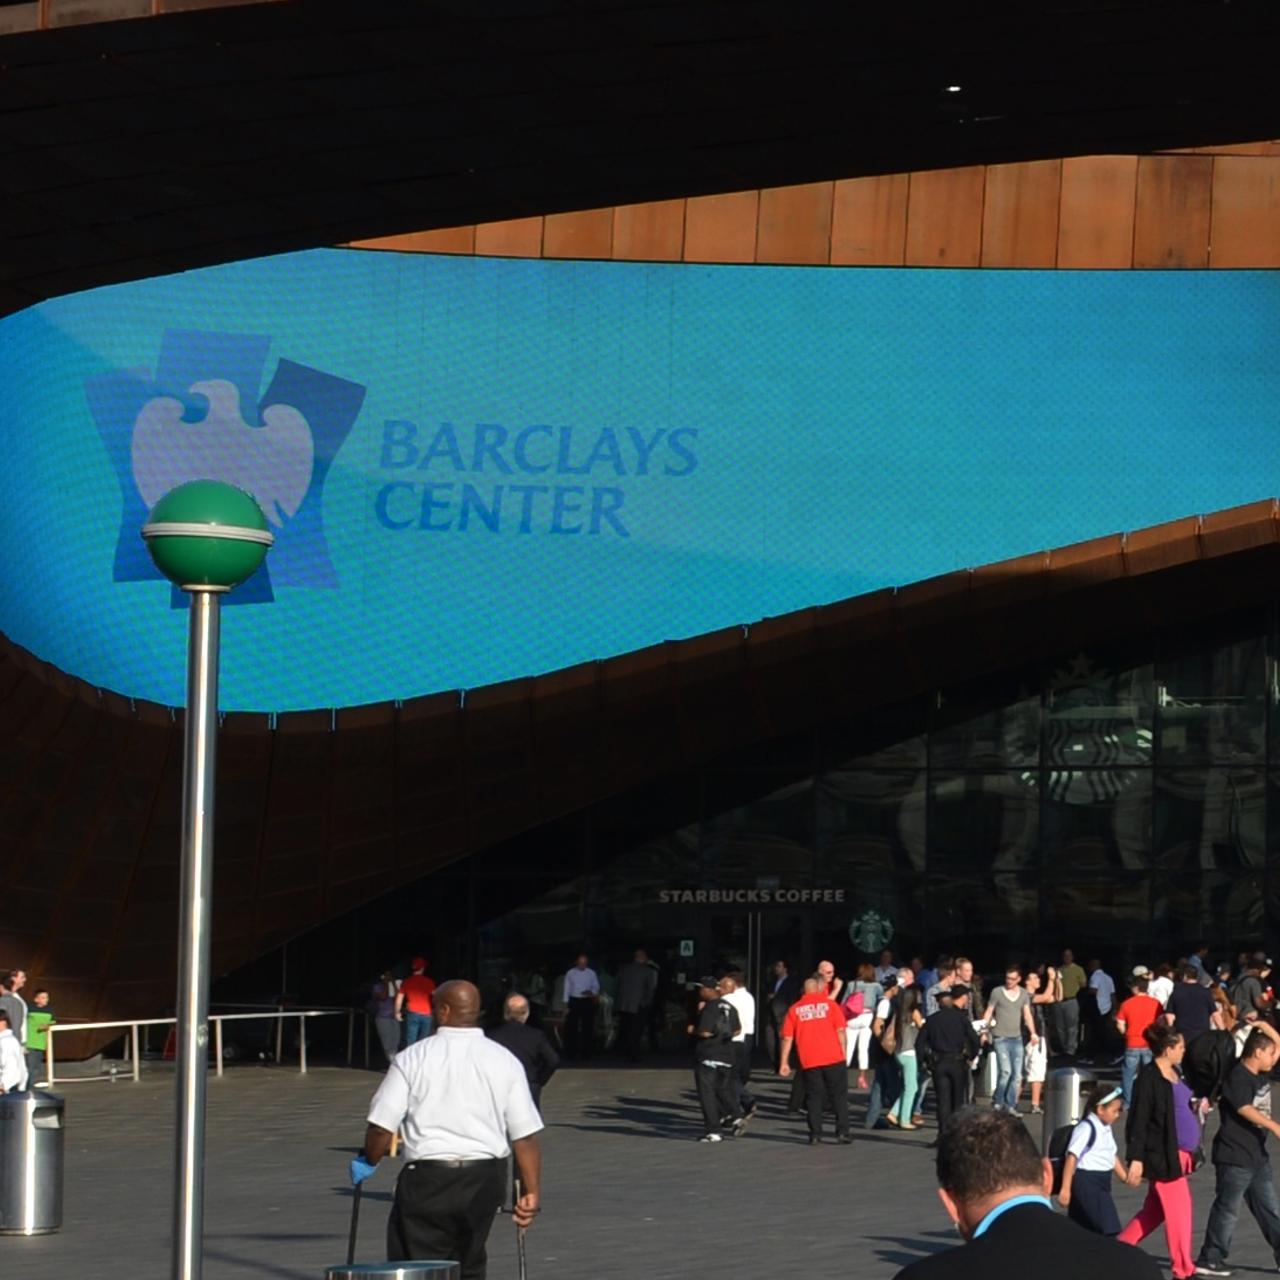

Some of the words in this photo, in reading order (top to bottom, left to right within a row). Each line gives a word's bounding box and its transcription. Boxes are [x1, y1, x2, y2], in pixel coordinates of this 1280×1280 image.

[379, 419, 701, 477] BARCLAYS
[374, 479, 631, 538] CENTER
[659, 889, 771, 903] STARBUCKS
[775, 889, 845, 903] COFFEE
